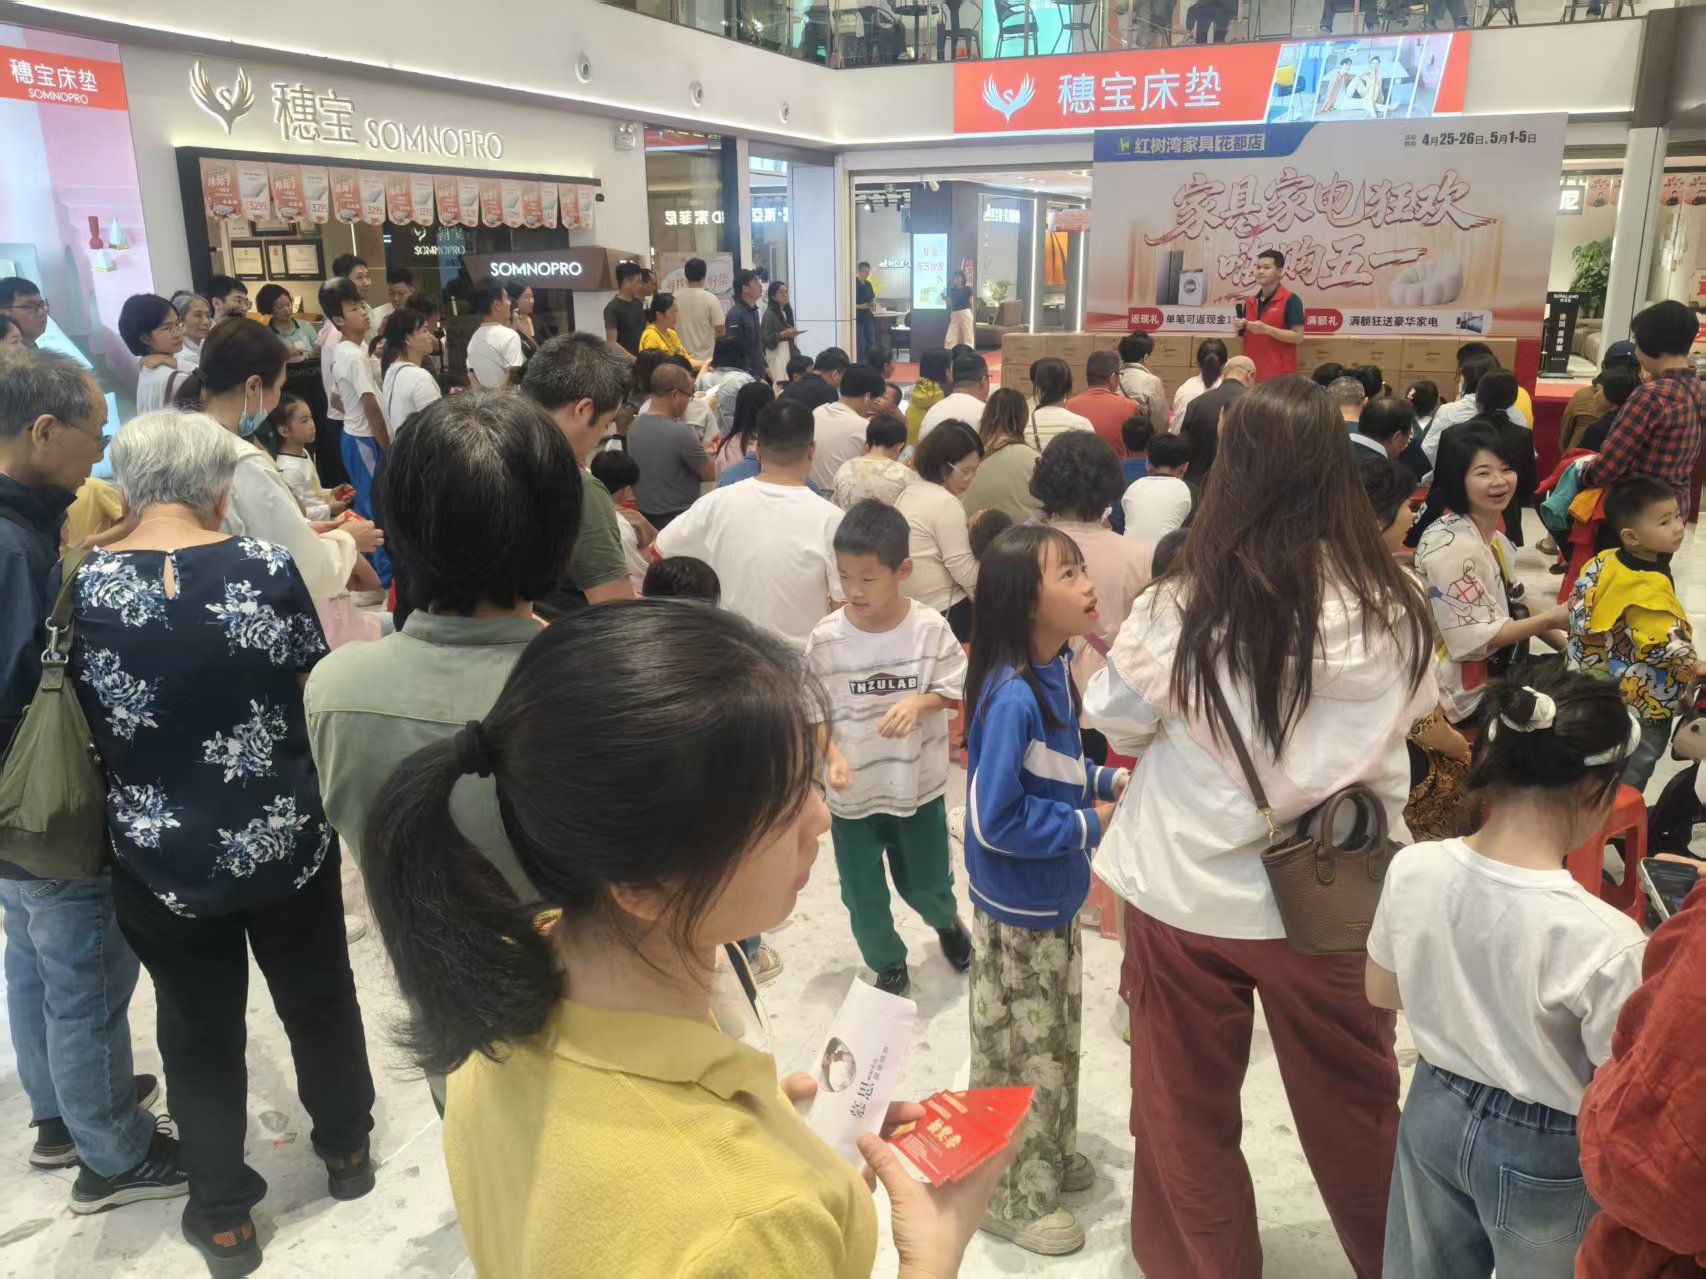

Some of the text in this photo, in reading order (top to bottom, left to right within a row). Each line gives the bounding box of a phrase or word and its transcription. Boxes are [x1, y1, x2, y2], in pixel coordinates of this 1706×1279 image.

[9, 59, 98, 92] 穗宝床垫
[28, 88, 89, 105] SOMNOPRO
[1057, 65, 1222, 116] 穗宝床垫
[271, 83, 504, 161] 穗宝 SOMNOPRO
[1144, 166, 1498, 247] 家具家电狂欢
[489, 261, 583, 277] SOMNOPRO
[1130, 314, 1160, 325] 返现礼
[1306, 315, 1339, 326] 满额礼
[1350, 315, 1439, 327] 满额狂送豪华家电
